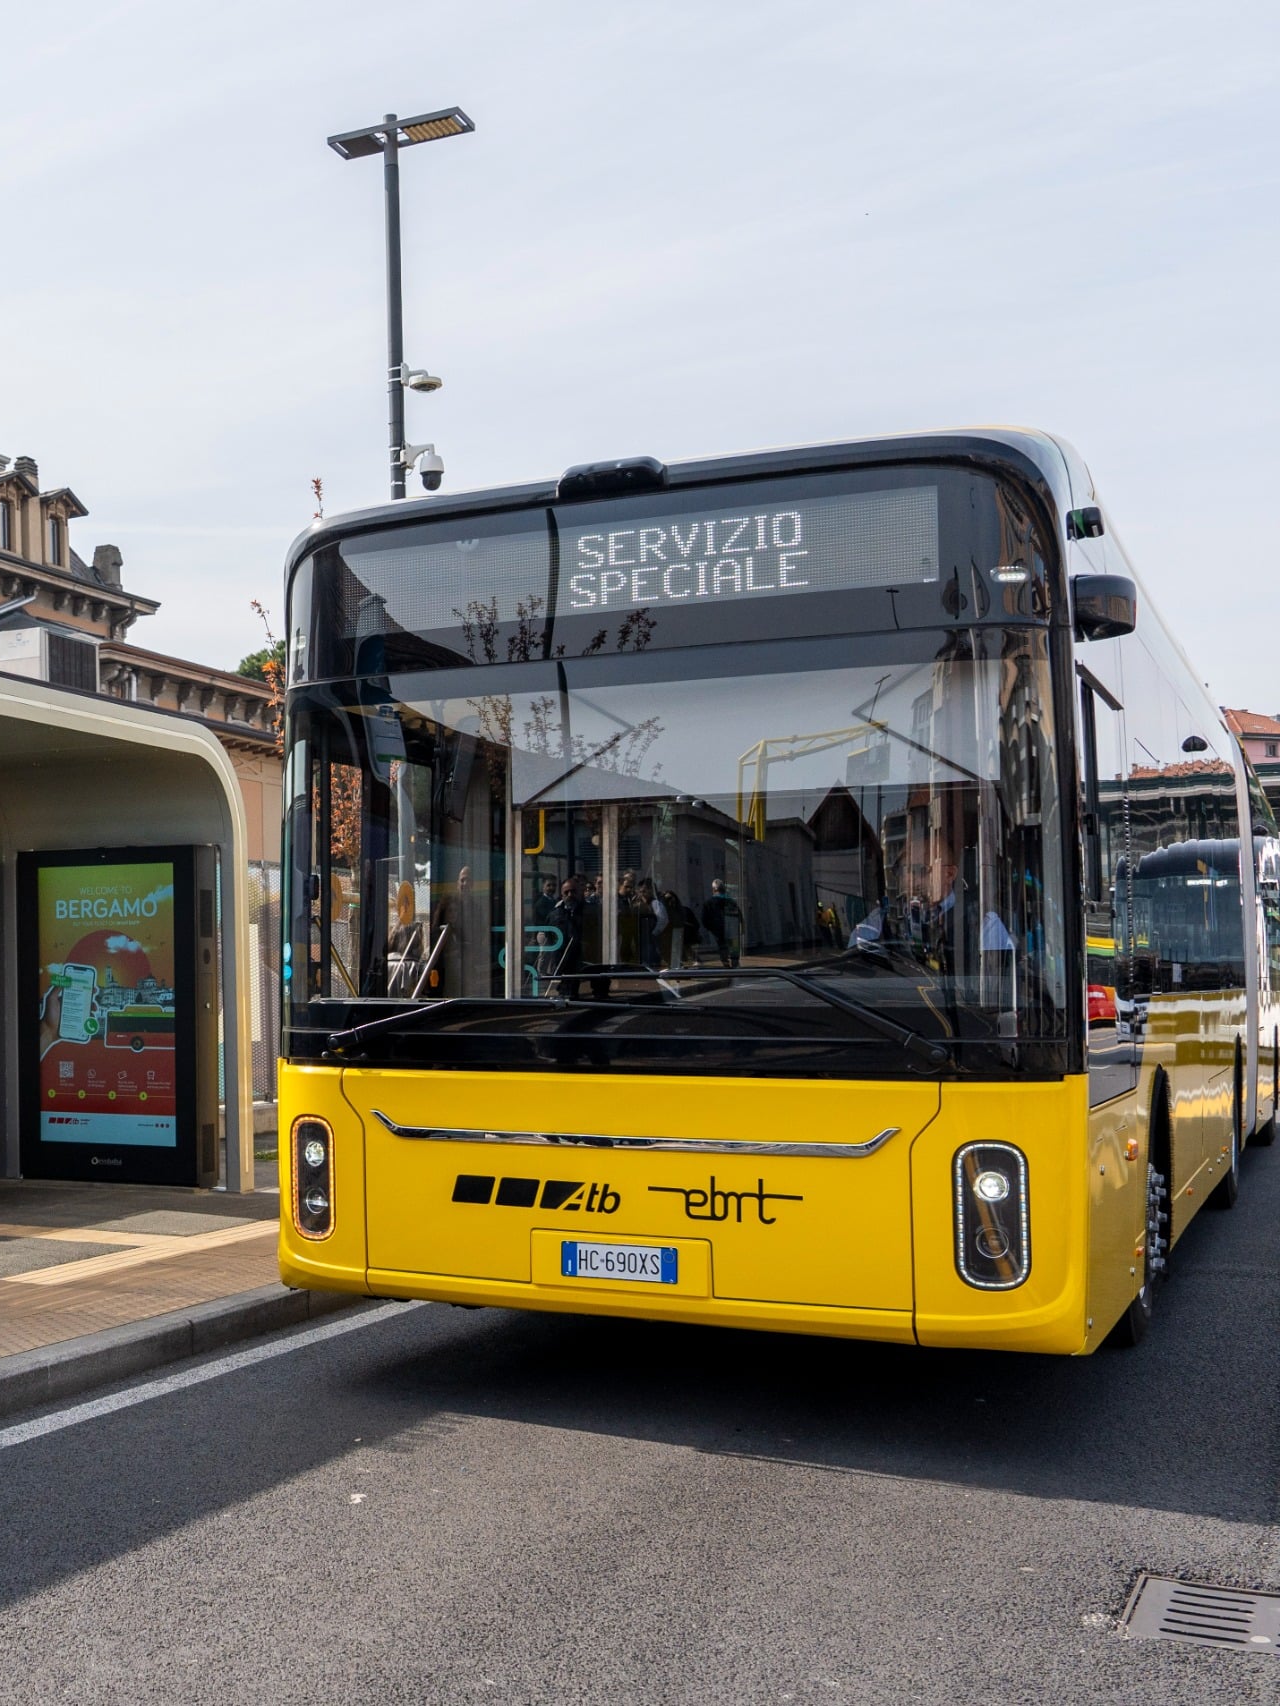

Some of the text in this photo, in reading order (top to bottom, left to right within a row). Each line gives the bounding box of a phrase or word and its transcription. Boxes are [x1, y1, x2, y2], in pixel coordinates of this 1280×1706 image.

[577, 511, 801, 569] SERVIZIO
[570, 550, 809, 608] SPECIALE
[55, 897, 158, 919] BERGAMO
[80, 884, 133, 896] WELCOME TO
